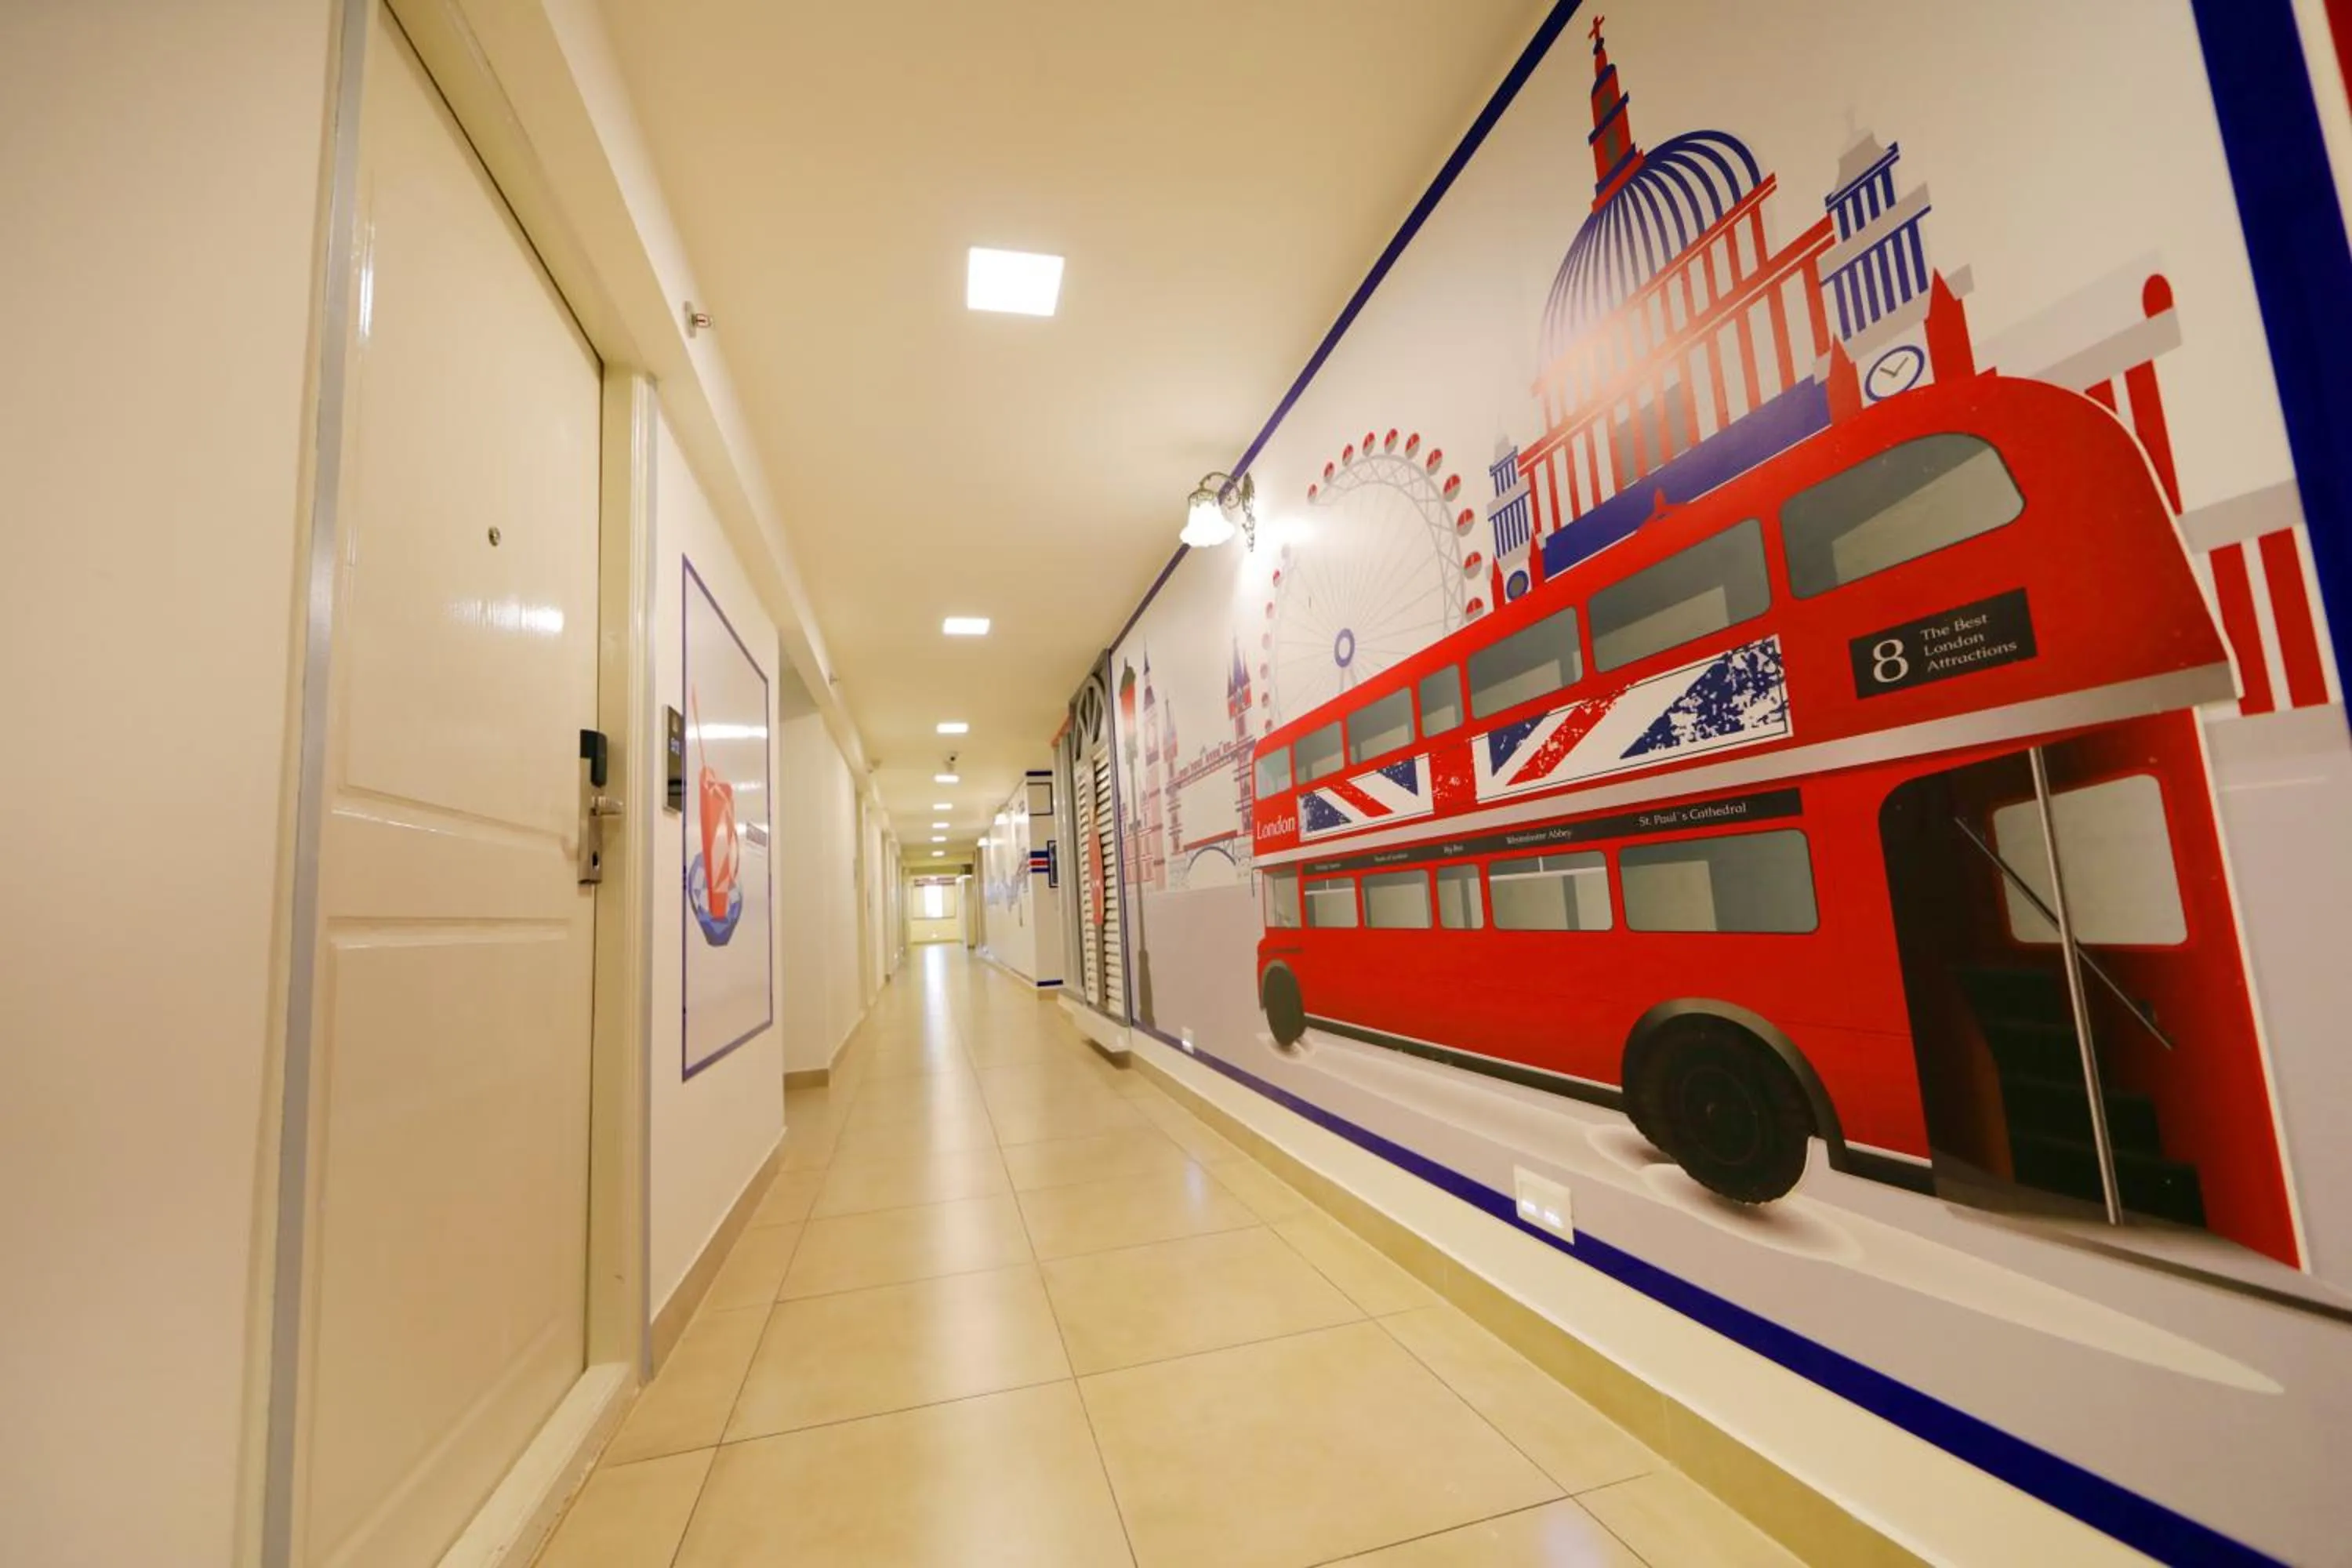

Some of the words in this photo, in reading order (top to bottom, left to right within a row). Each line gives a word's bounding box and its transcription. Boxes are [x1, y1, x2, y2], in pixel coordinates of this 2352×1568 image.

[1919, 626, 1951, 641] The
[1954, 614, 1987, 632] Best
[1924, 633, 1985, 657] London
[1927, 641, 2018, 673] Attractions
[1872, 638, 1909, 684] 8
[1690, 802, 1748, 820] Cathedral
[1257, 815, 1296, 840] London
